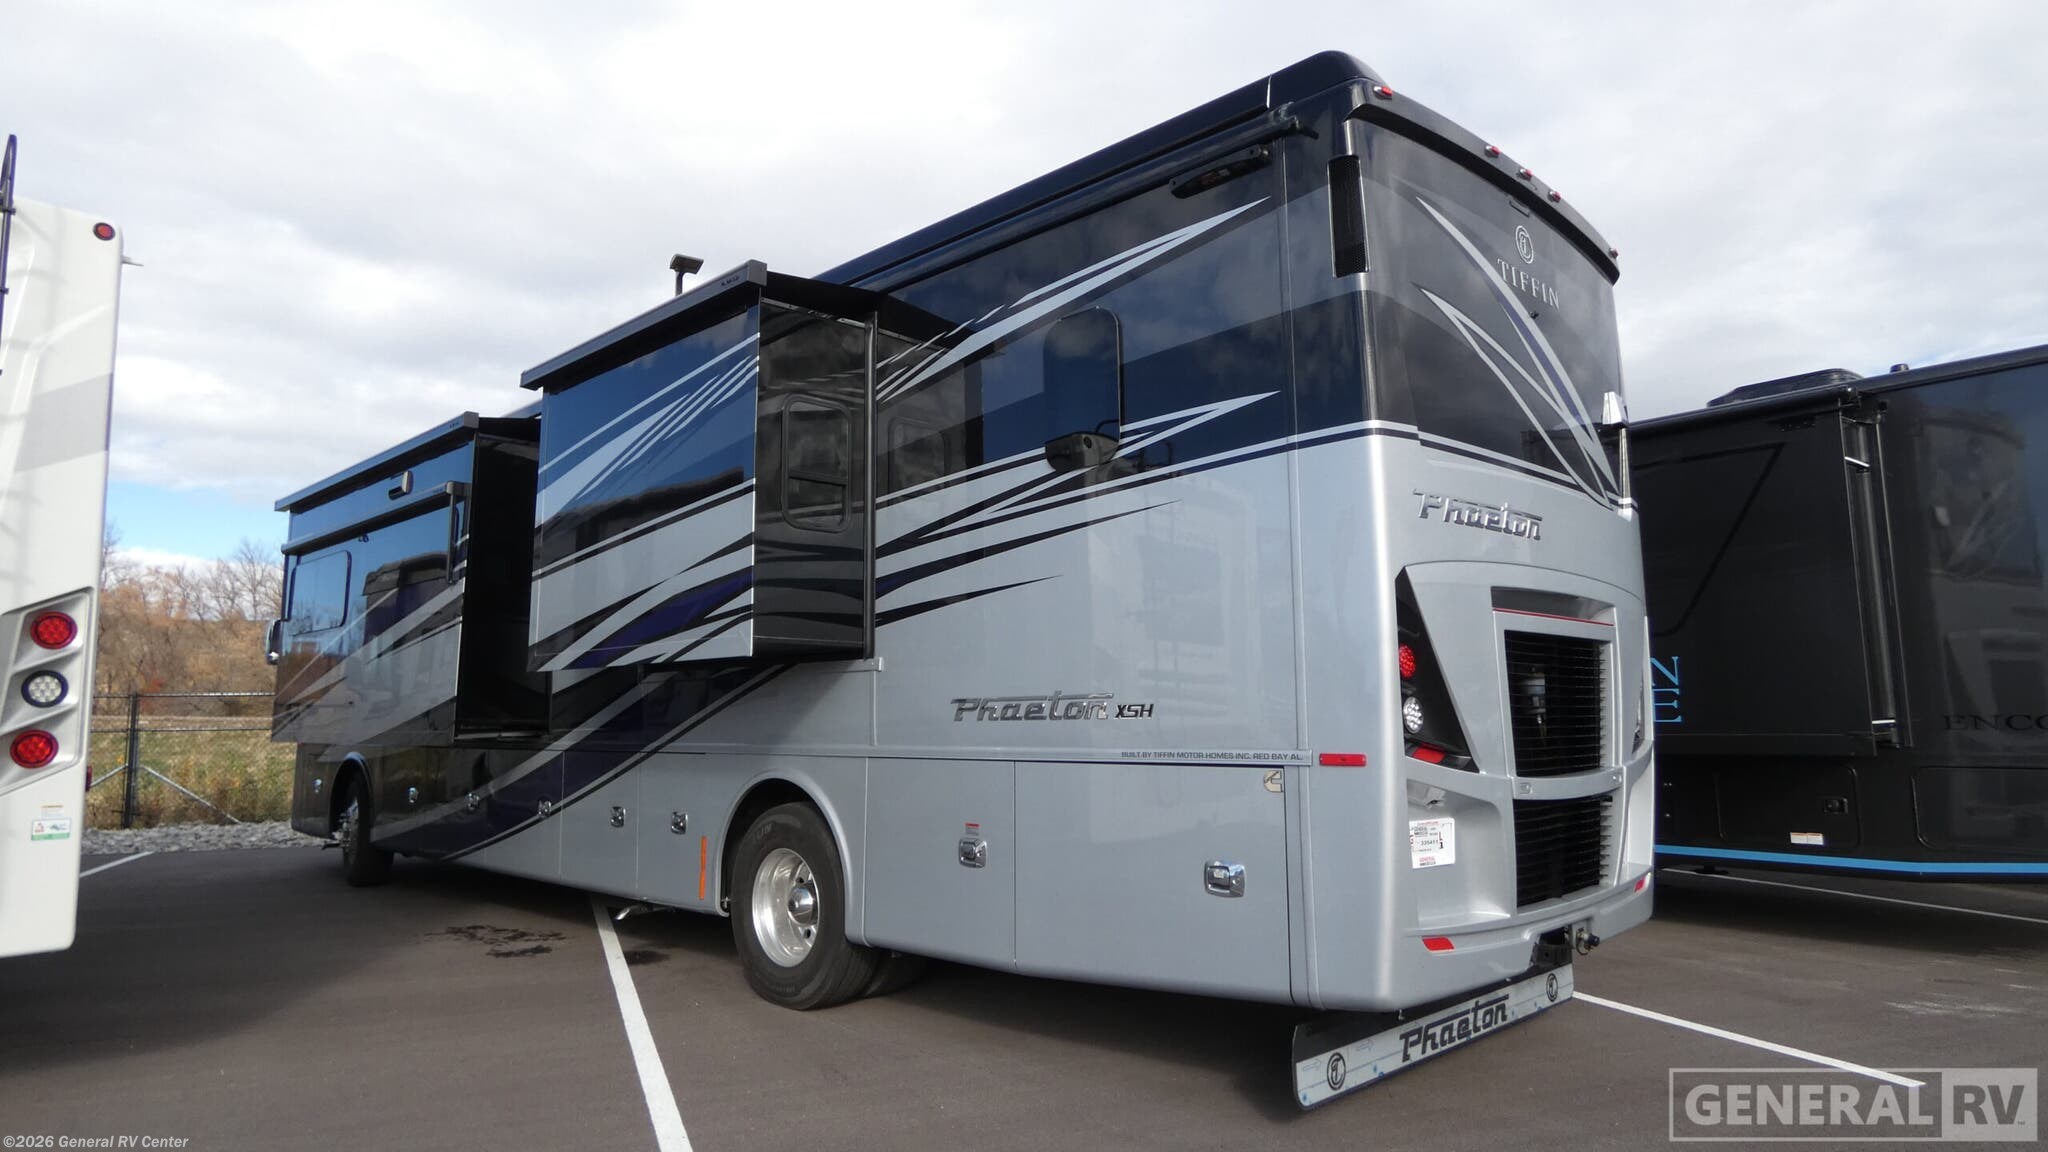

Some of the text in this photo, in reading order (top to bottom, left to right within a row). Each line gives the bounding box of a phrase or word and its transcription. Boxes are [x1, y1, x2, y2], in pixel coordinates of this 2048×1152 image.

[1497, 258, 1560, 312] TIFFIN
[1412, 488, 1542, 541] Phaeton
[951, 690, 1155, 722] Phaeton XSH
[1121, 751, 1142, 759] BUILT
[1143, 751, 1152, 759] BY
[1153, 751, 1175, 759] TIFFIN
[1205, 752, 1234, 760] HOMES
[1271, 753, 1289, 761] BAY
[1400, 994, 1509, 1063] Phaeton
